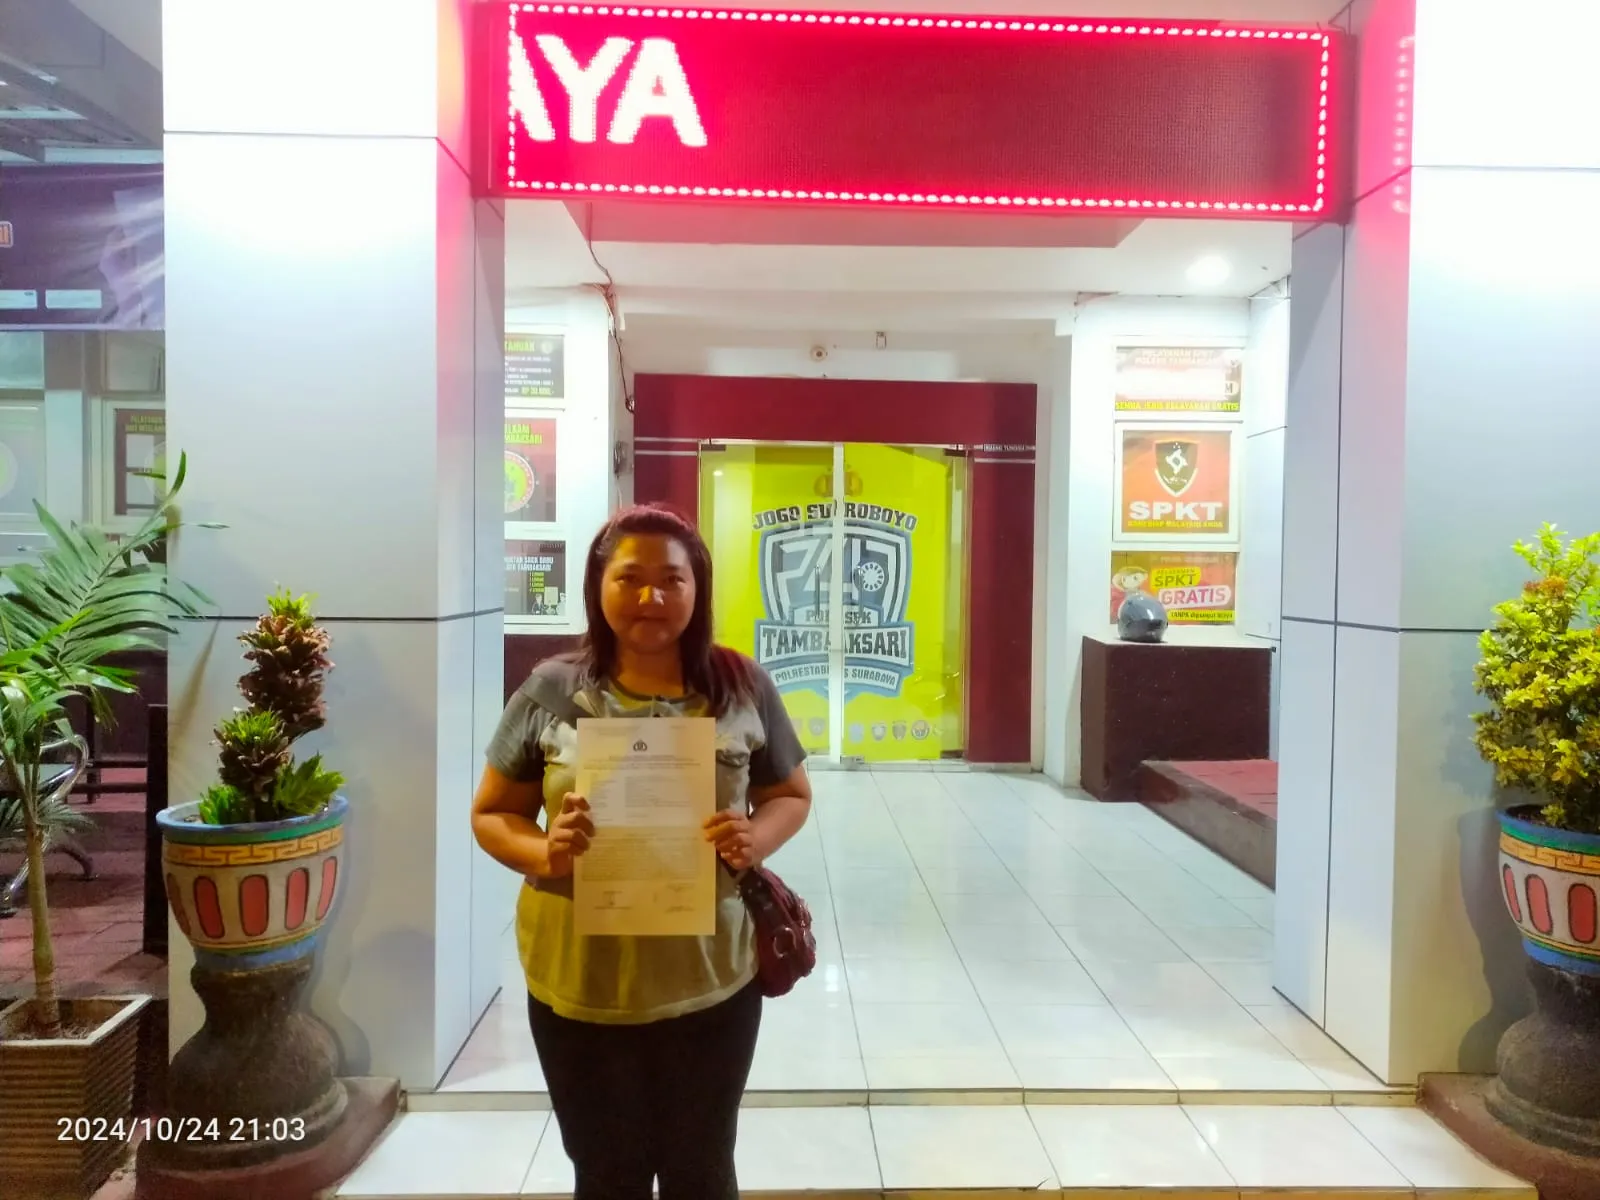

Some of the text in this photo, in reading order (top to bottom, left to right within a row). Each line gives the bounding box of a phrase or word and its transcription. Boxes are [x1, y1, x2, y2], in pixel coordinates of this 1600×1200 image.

[753, 506, 801, 530] JOGO
[1128, 501, 1223, 521] SPKT
[1154, 574, 1197, 587] SPKT
[1161, 588, 1226, 605] GRATIS
[775, 663, 896, 686] POLRESTABS SURABAYA
